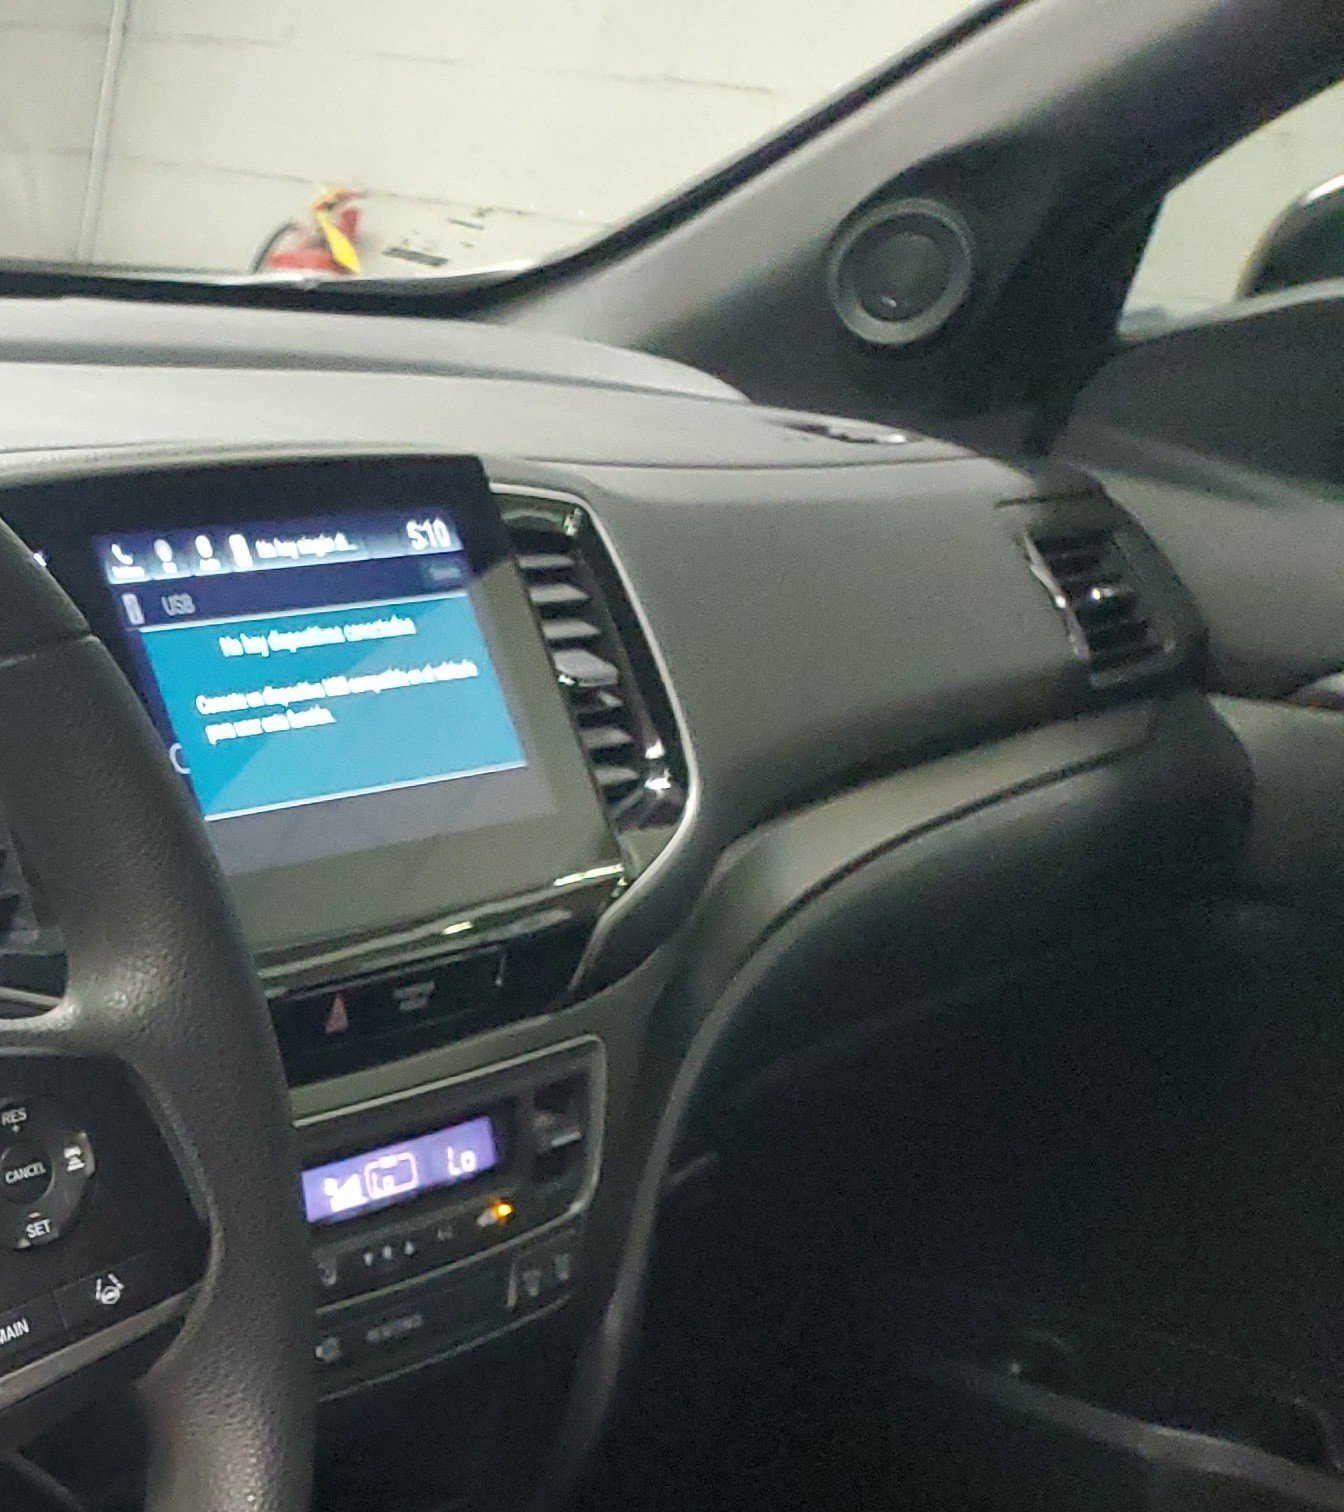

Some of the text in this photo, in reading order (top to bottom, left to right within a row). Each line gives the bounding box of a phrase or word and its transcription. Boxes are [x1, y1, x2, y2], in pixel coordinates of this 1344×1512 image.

[162, 593, 196, 616] USB
[1, 1106, 28, 1126] RES
[5, 1161, 47, 1185] CANCEL
[26, 1218, 53, 1239] SET
